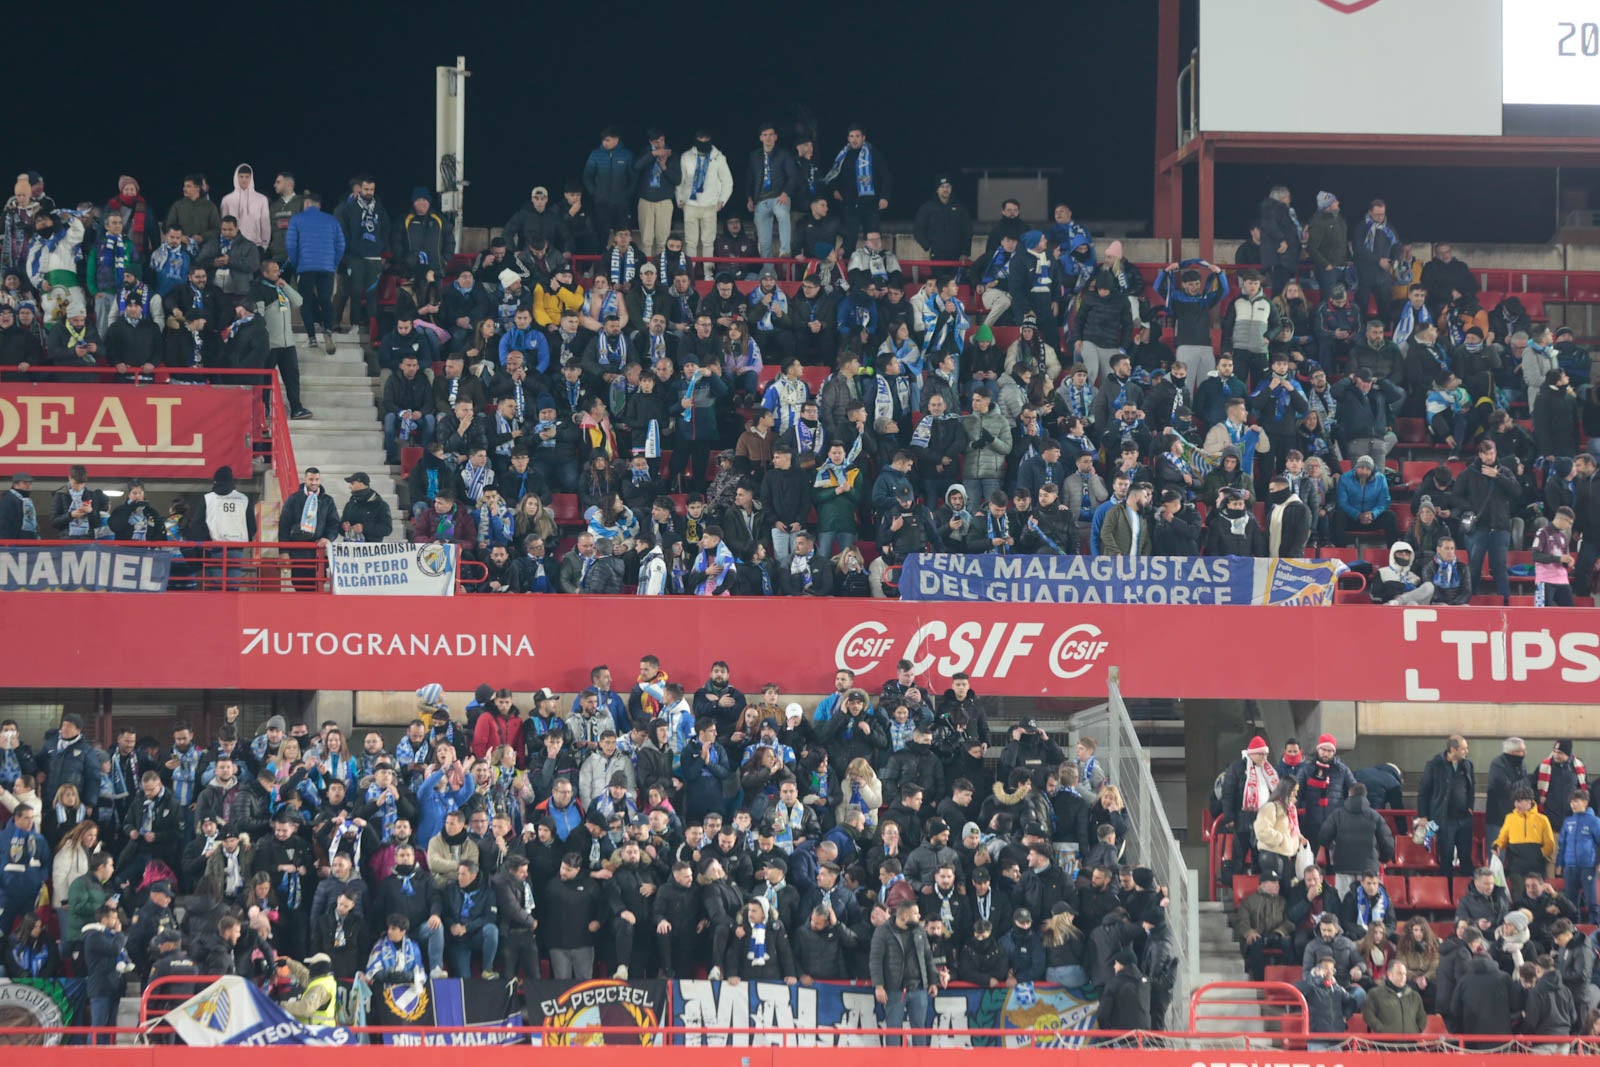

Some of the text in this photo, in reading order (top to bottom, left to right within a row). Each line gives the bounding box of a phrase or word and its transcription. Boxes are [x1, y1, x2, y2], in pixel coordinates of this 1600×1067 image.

[1557, 21, 1600, 57] 20
[223, 502, 236, 513] 69
[335, 558, 409, 574] SAN PEDRO
[353, 543, 417, 558] MALAGUISTA
[0, 548, 163, 591] NAMIEL
[919, 569, 979, 599] DEL
[993, 554, 1231, 583] MALAGUISTAS
[240, 628, 536, 657] AUTOGRANADINA
[846, 620, 1109, 678] CSIF CSIF CSIF
[1440, 629, 1600, 683] TIPS
[540, 985, 655, 1017] EL PERCHEL
[679, 979, 974, 1048] MALAA
